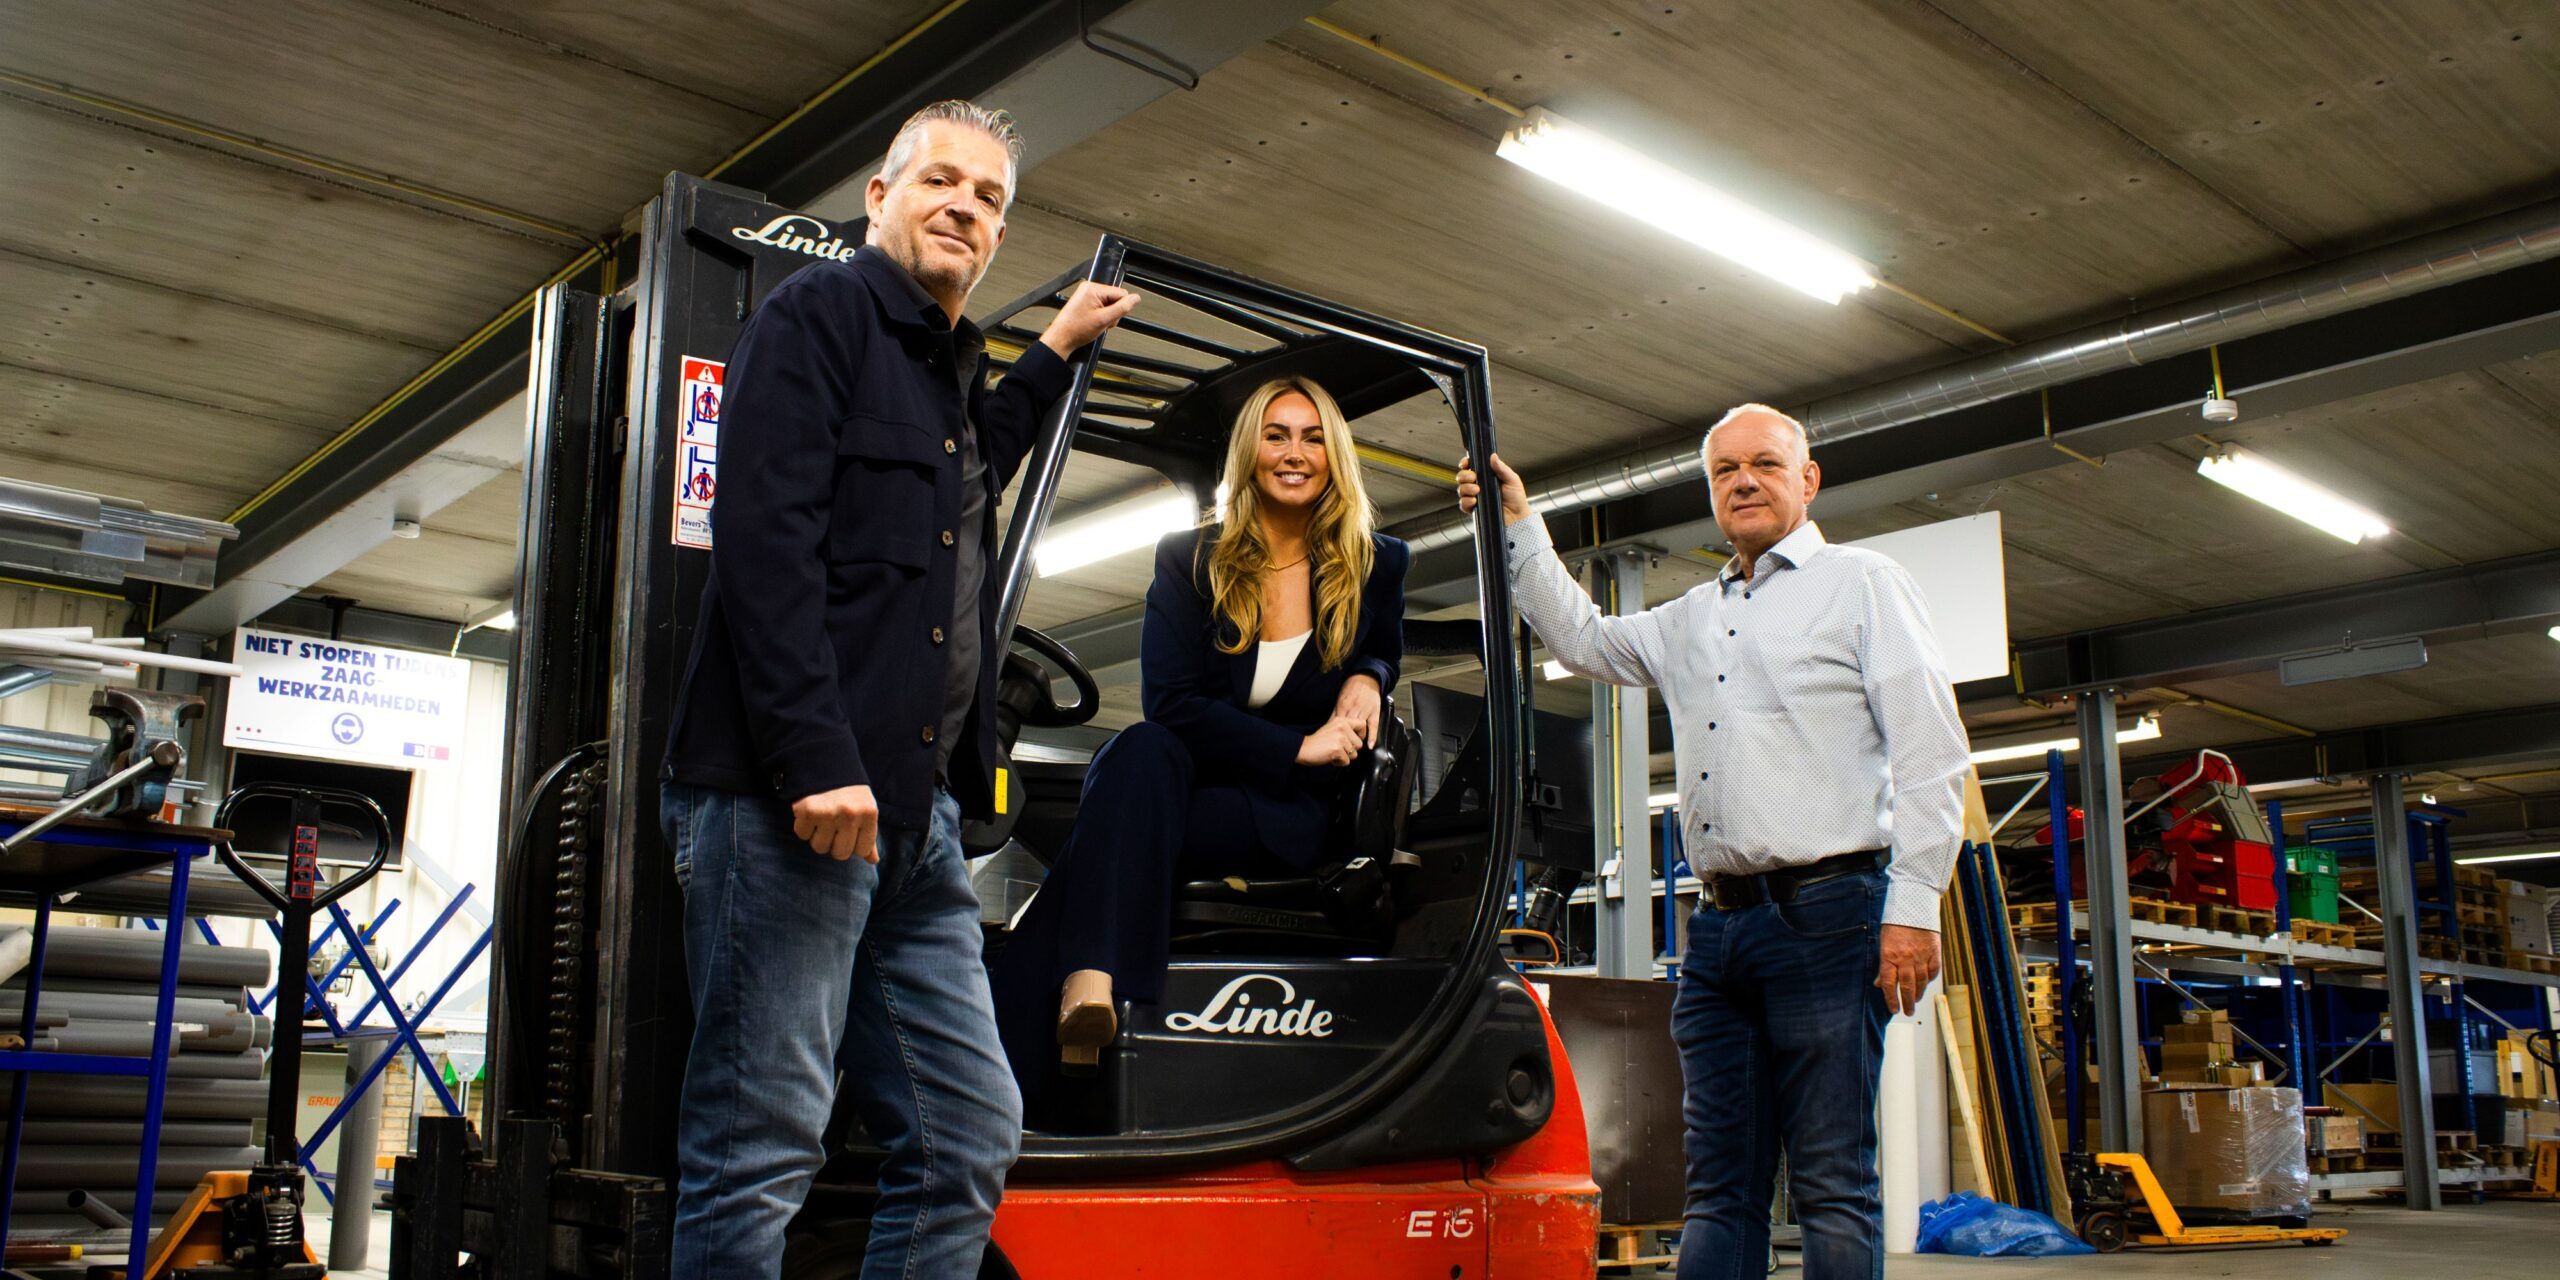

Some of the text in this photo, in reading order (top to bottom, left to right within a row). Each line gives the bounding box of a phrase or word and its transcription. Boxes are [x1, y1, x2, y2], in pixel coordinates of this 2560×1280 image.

[732, 215, 856, 263] Linde
[245, 634, 293, 656] NIET
[299, 641, 376, 668] STOREN
[258, 676, 441, 716] WERKZAAMHEDEN
[1165, 973, 1334, 1037] Linde
[1406, 1210, 1437, 1238] E
